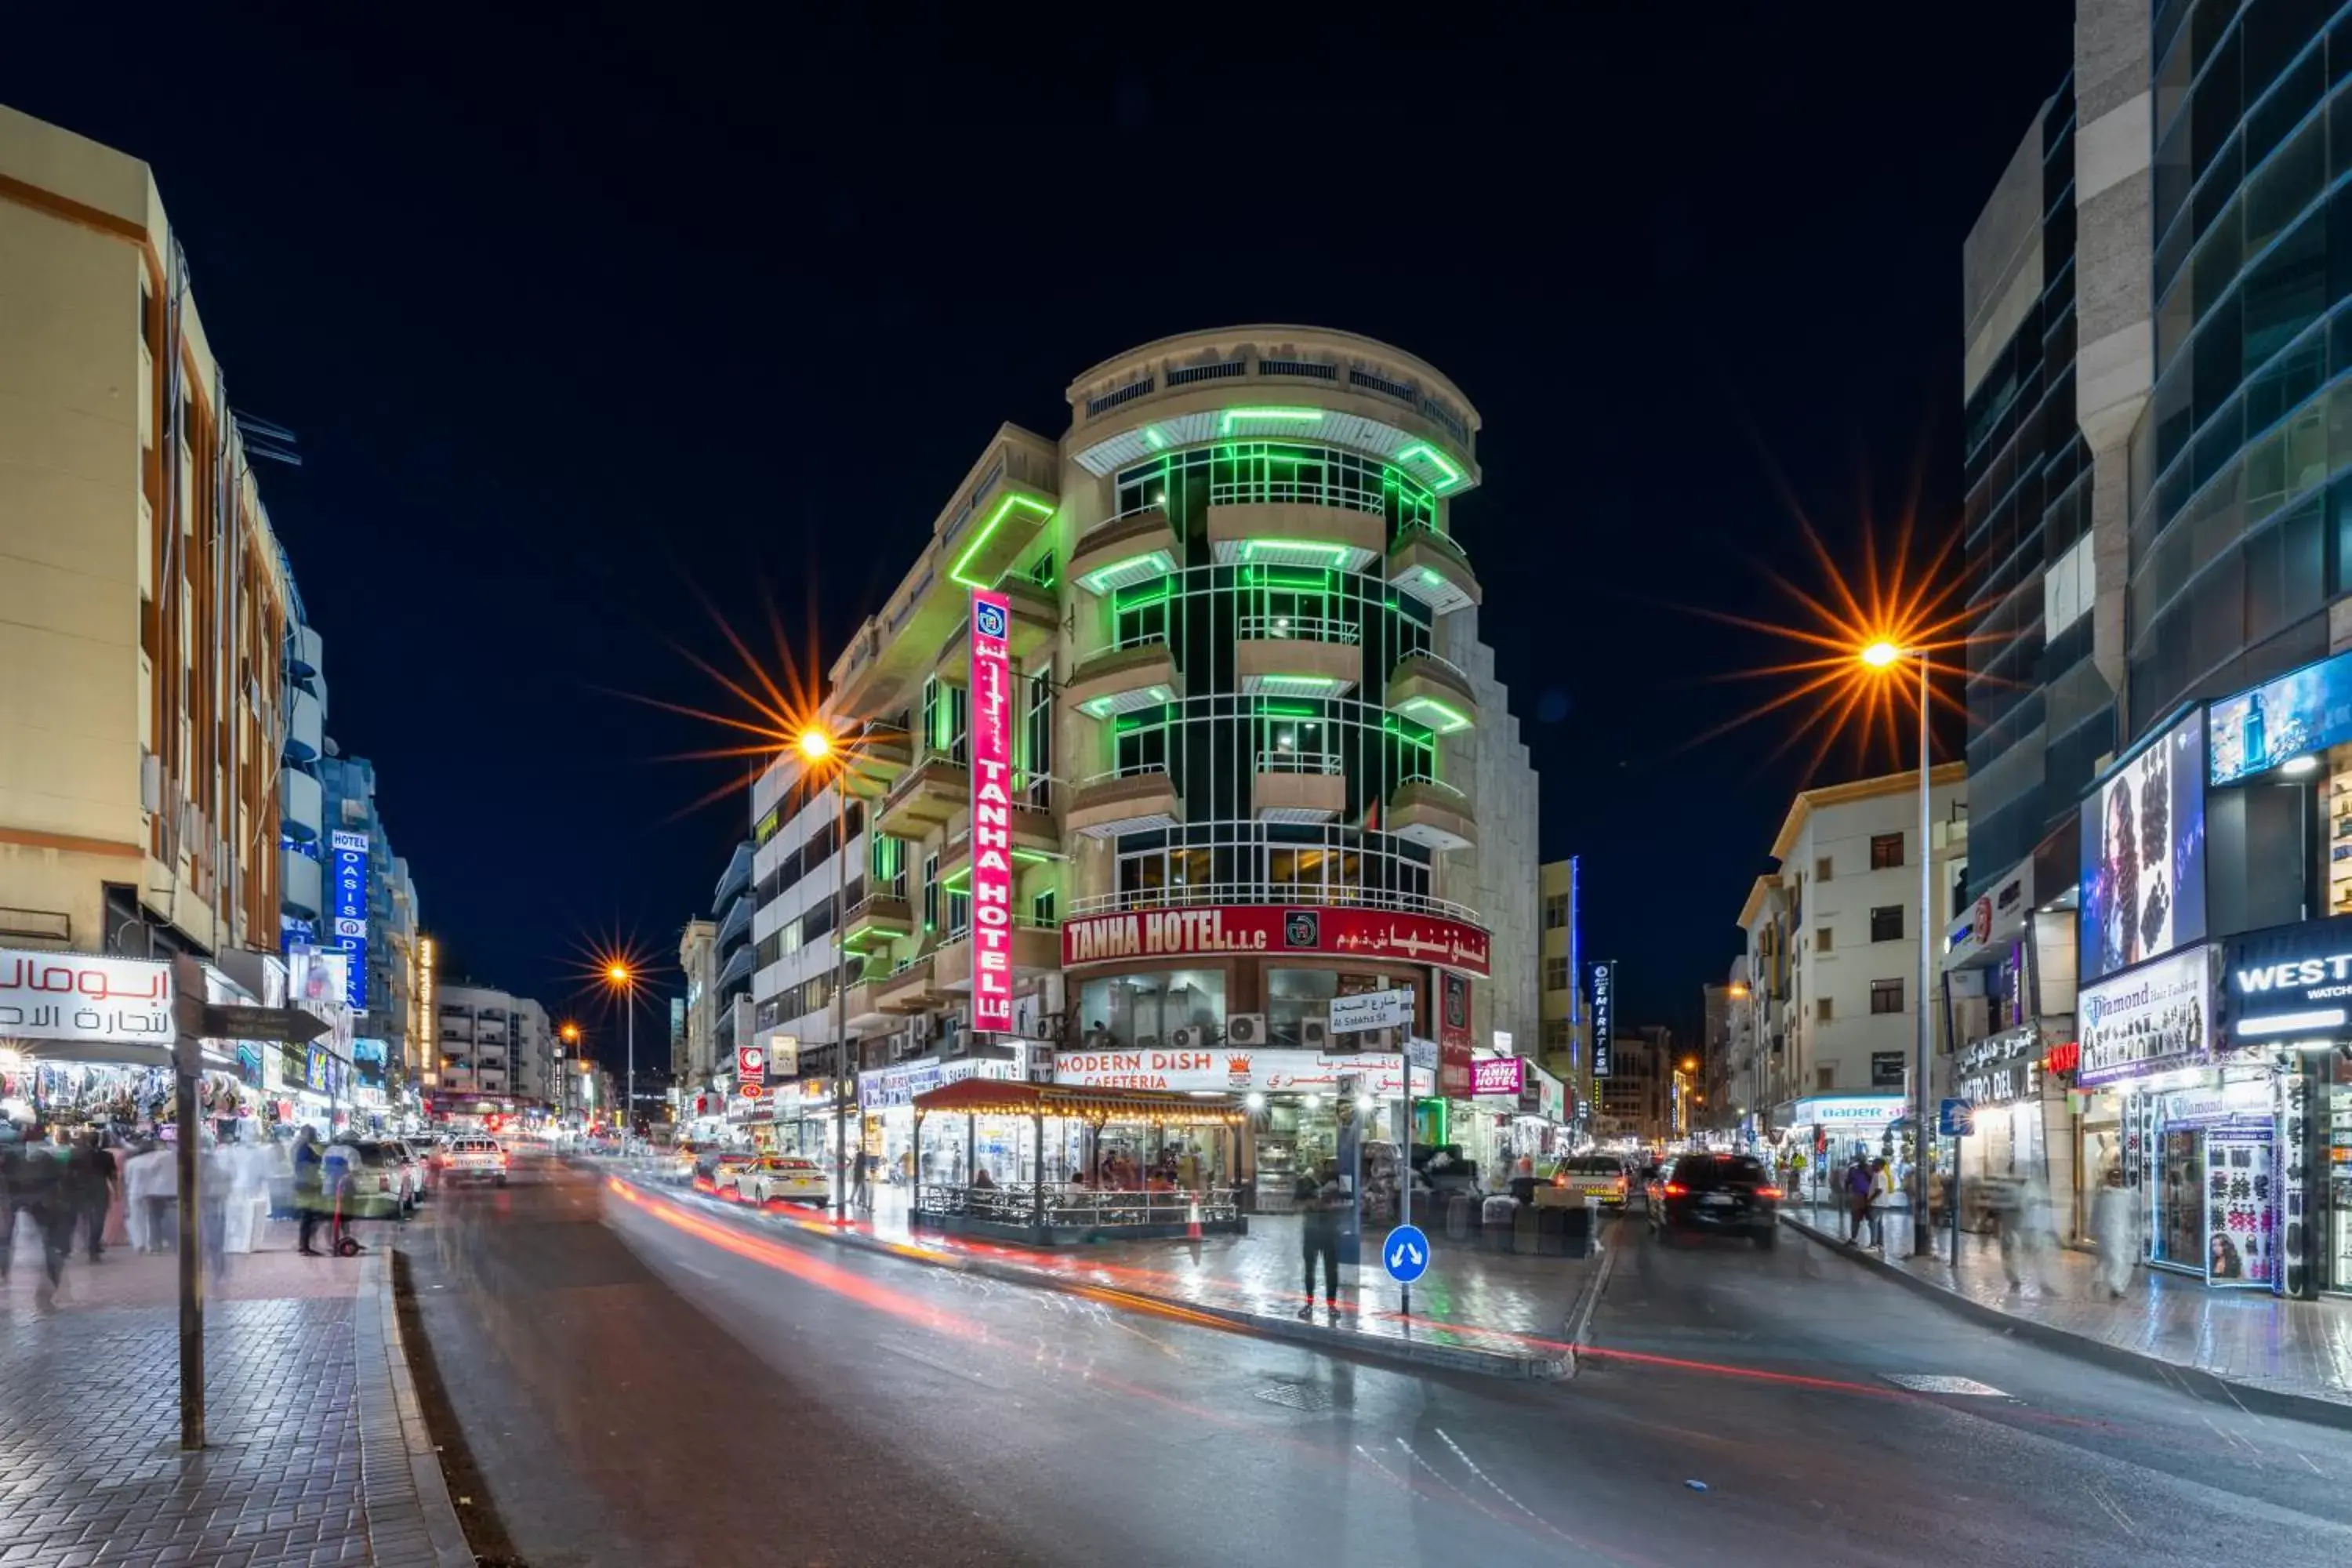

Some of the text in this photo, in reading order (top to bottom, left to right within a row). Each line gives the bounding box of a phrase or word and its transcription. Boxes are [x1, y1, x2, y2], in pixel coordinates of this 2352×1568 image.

[978, 758, 1007, 871] TANHA
[335, 833, 366, 848] HOTEL
[343, 852, 358, 916] OASIS
[978, 882, 1007, 993] HOTEL
[1069, 915, 1140, 962] TANHA
[1145, 909, 1225, 954] HOTEL
[2237, 954, 2352, 993] WEST
[2092, 981, 2149, 1018] Diamond
[1595, 986, 1607, 1067] EMIRATES
[1056, 1052, 1212, 1073] MODERN DISH
[1084, 1074, 1167, 1089] CAFETERIA
